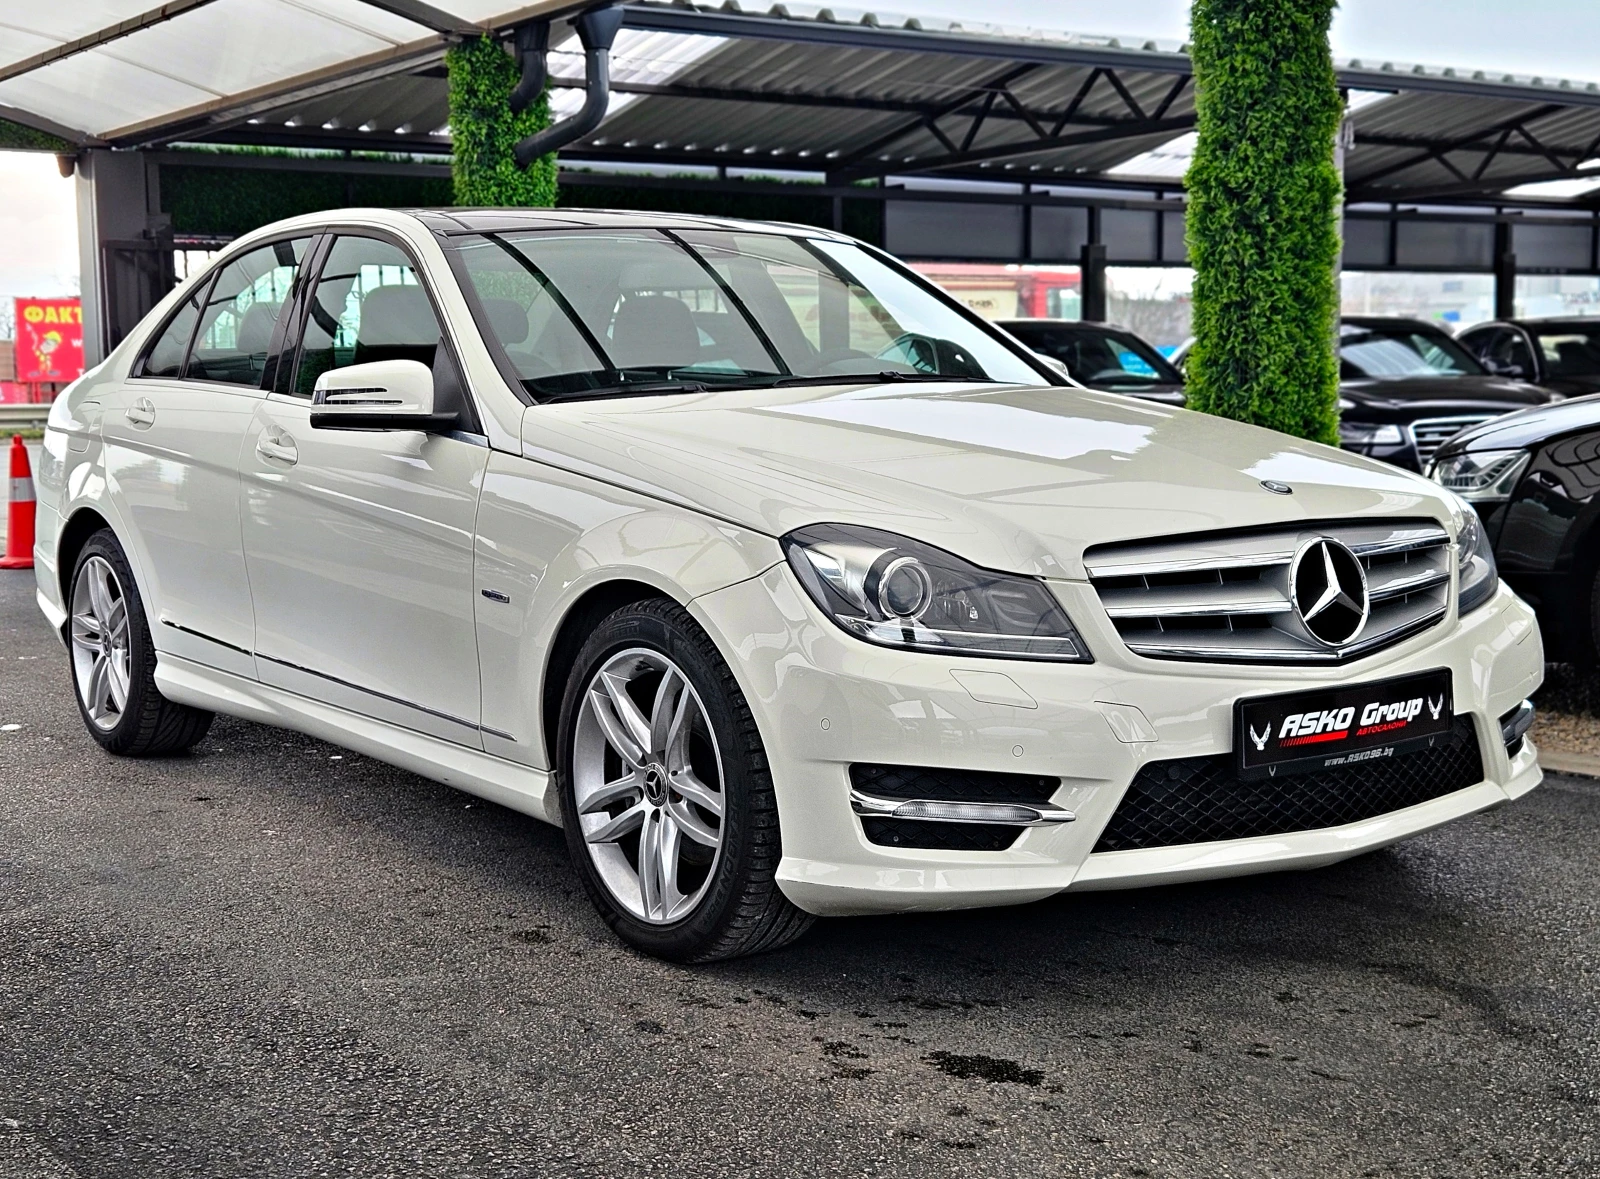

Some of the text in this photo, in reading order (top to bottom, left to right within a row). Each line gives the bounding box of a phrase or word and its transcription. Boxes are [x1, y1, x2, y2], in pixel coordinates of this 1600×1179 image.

[1278, 697, 1423, 739] ASKO Group
[1356, 720, 1407, 736] АВТОСАЛОНИ
[1324, 746, 1395, 767] www.ASKO96.bg
